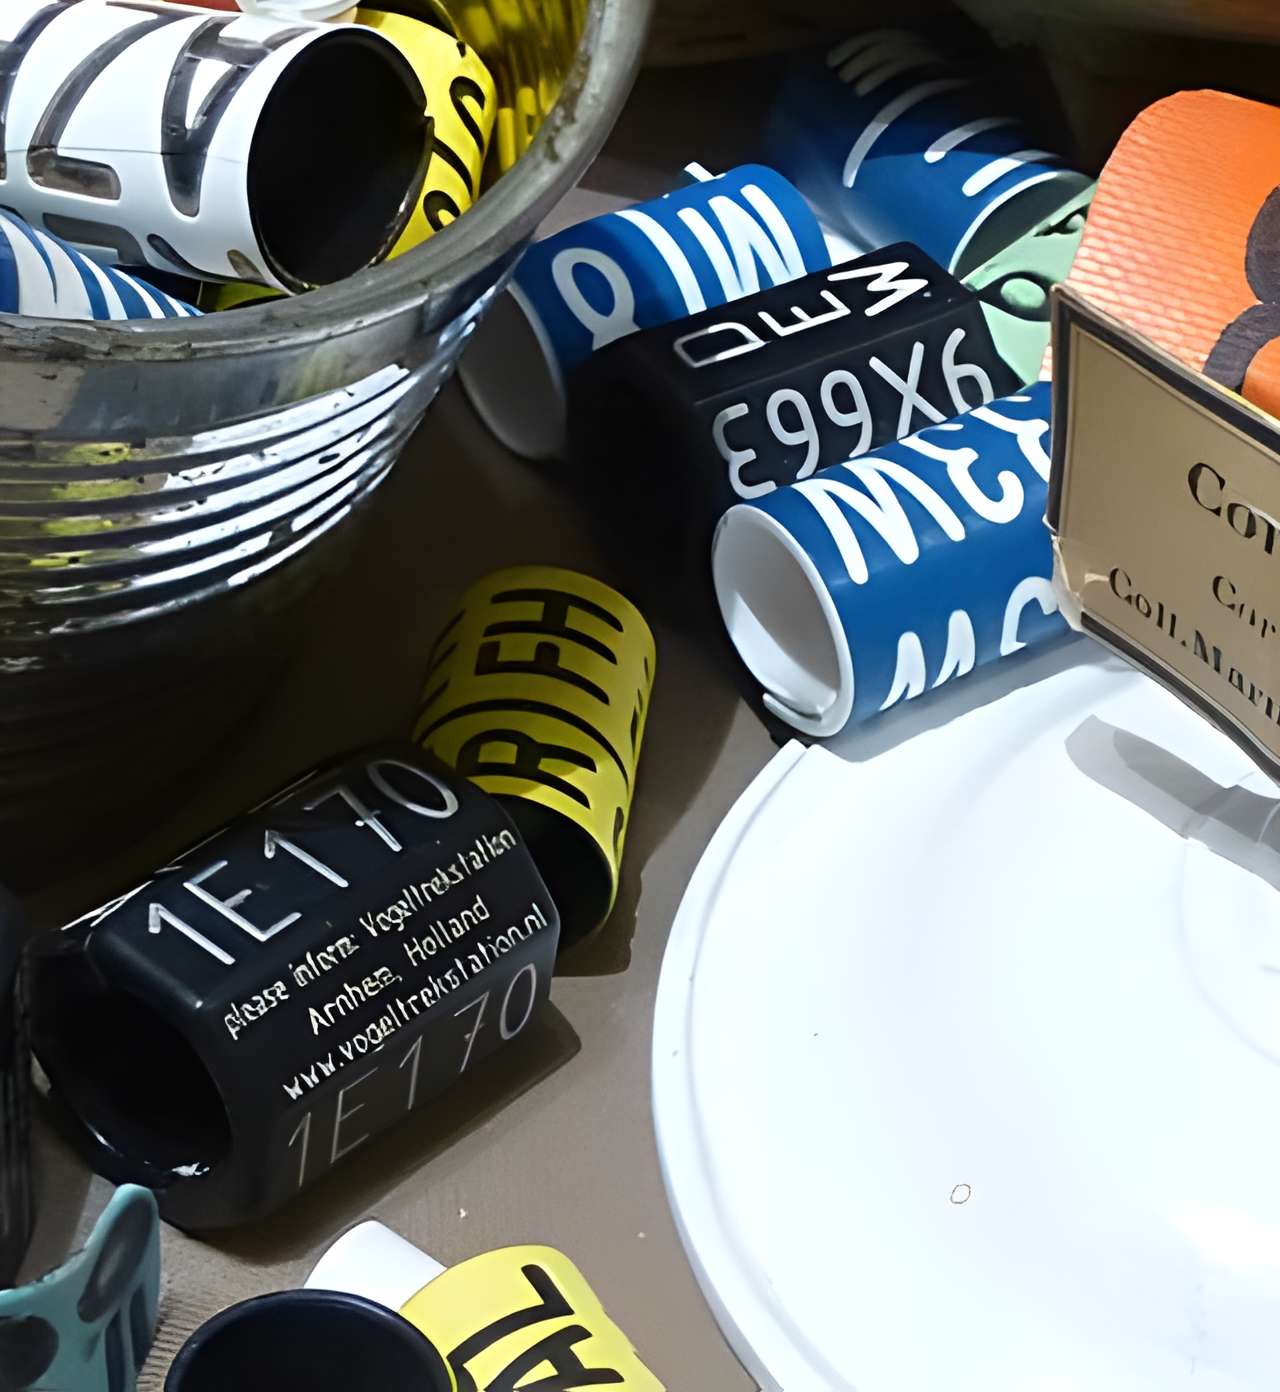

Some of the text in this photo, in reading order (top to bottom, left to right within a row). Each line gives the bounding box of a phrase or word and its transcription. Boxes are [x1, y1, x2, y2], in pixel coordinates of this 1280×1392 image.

[148, 759, 459, 965] 1E170
[403, 894, 491, 967] Holland
[288, 962, 538, 1188] 1E170
